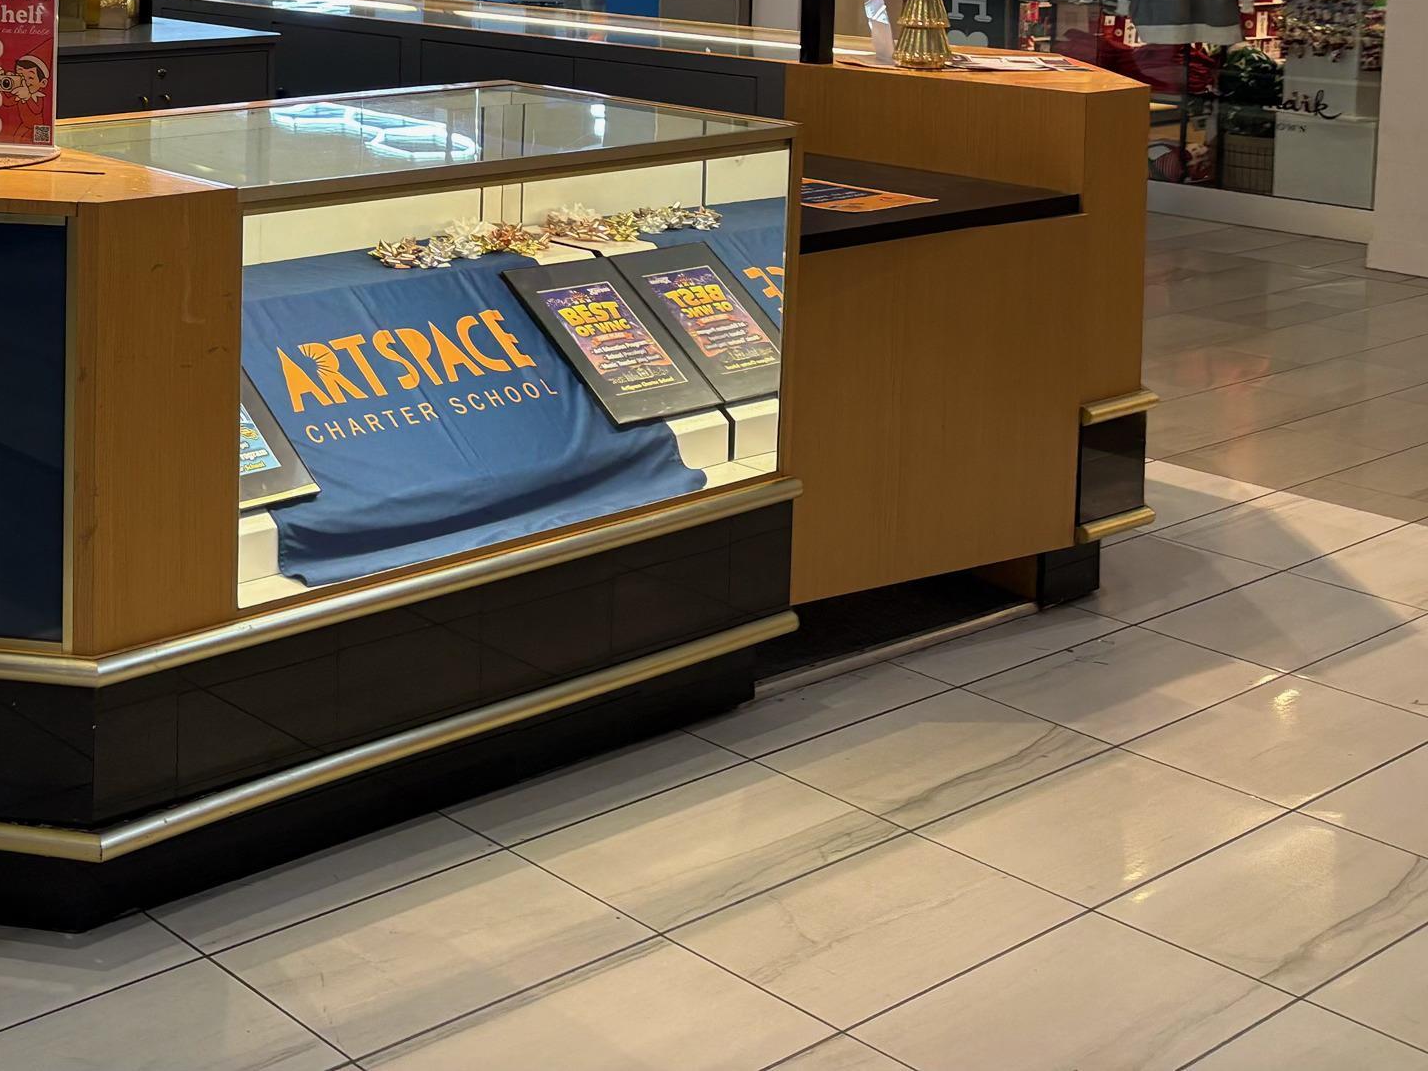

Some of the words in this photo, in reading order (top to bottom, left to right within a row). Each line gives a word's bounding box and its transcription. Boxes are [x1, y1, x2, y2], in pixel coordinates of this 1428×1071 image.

[557, 301, 620, 327] BEST
[575, 323, 596, 337] OF
[597, 318, 632, 333] WNC
[305, 402, 439, 444] CHARTER
[450, 379, 558, 415] SCHOOL
[240, 449, 269, 461] rogram
